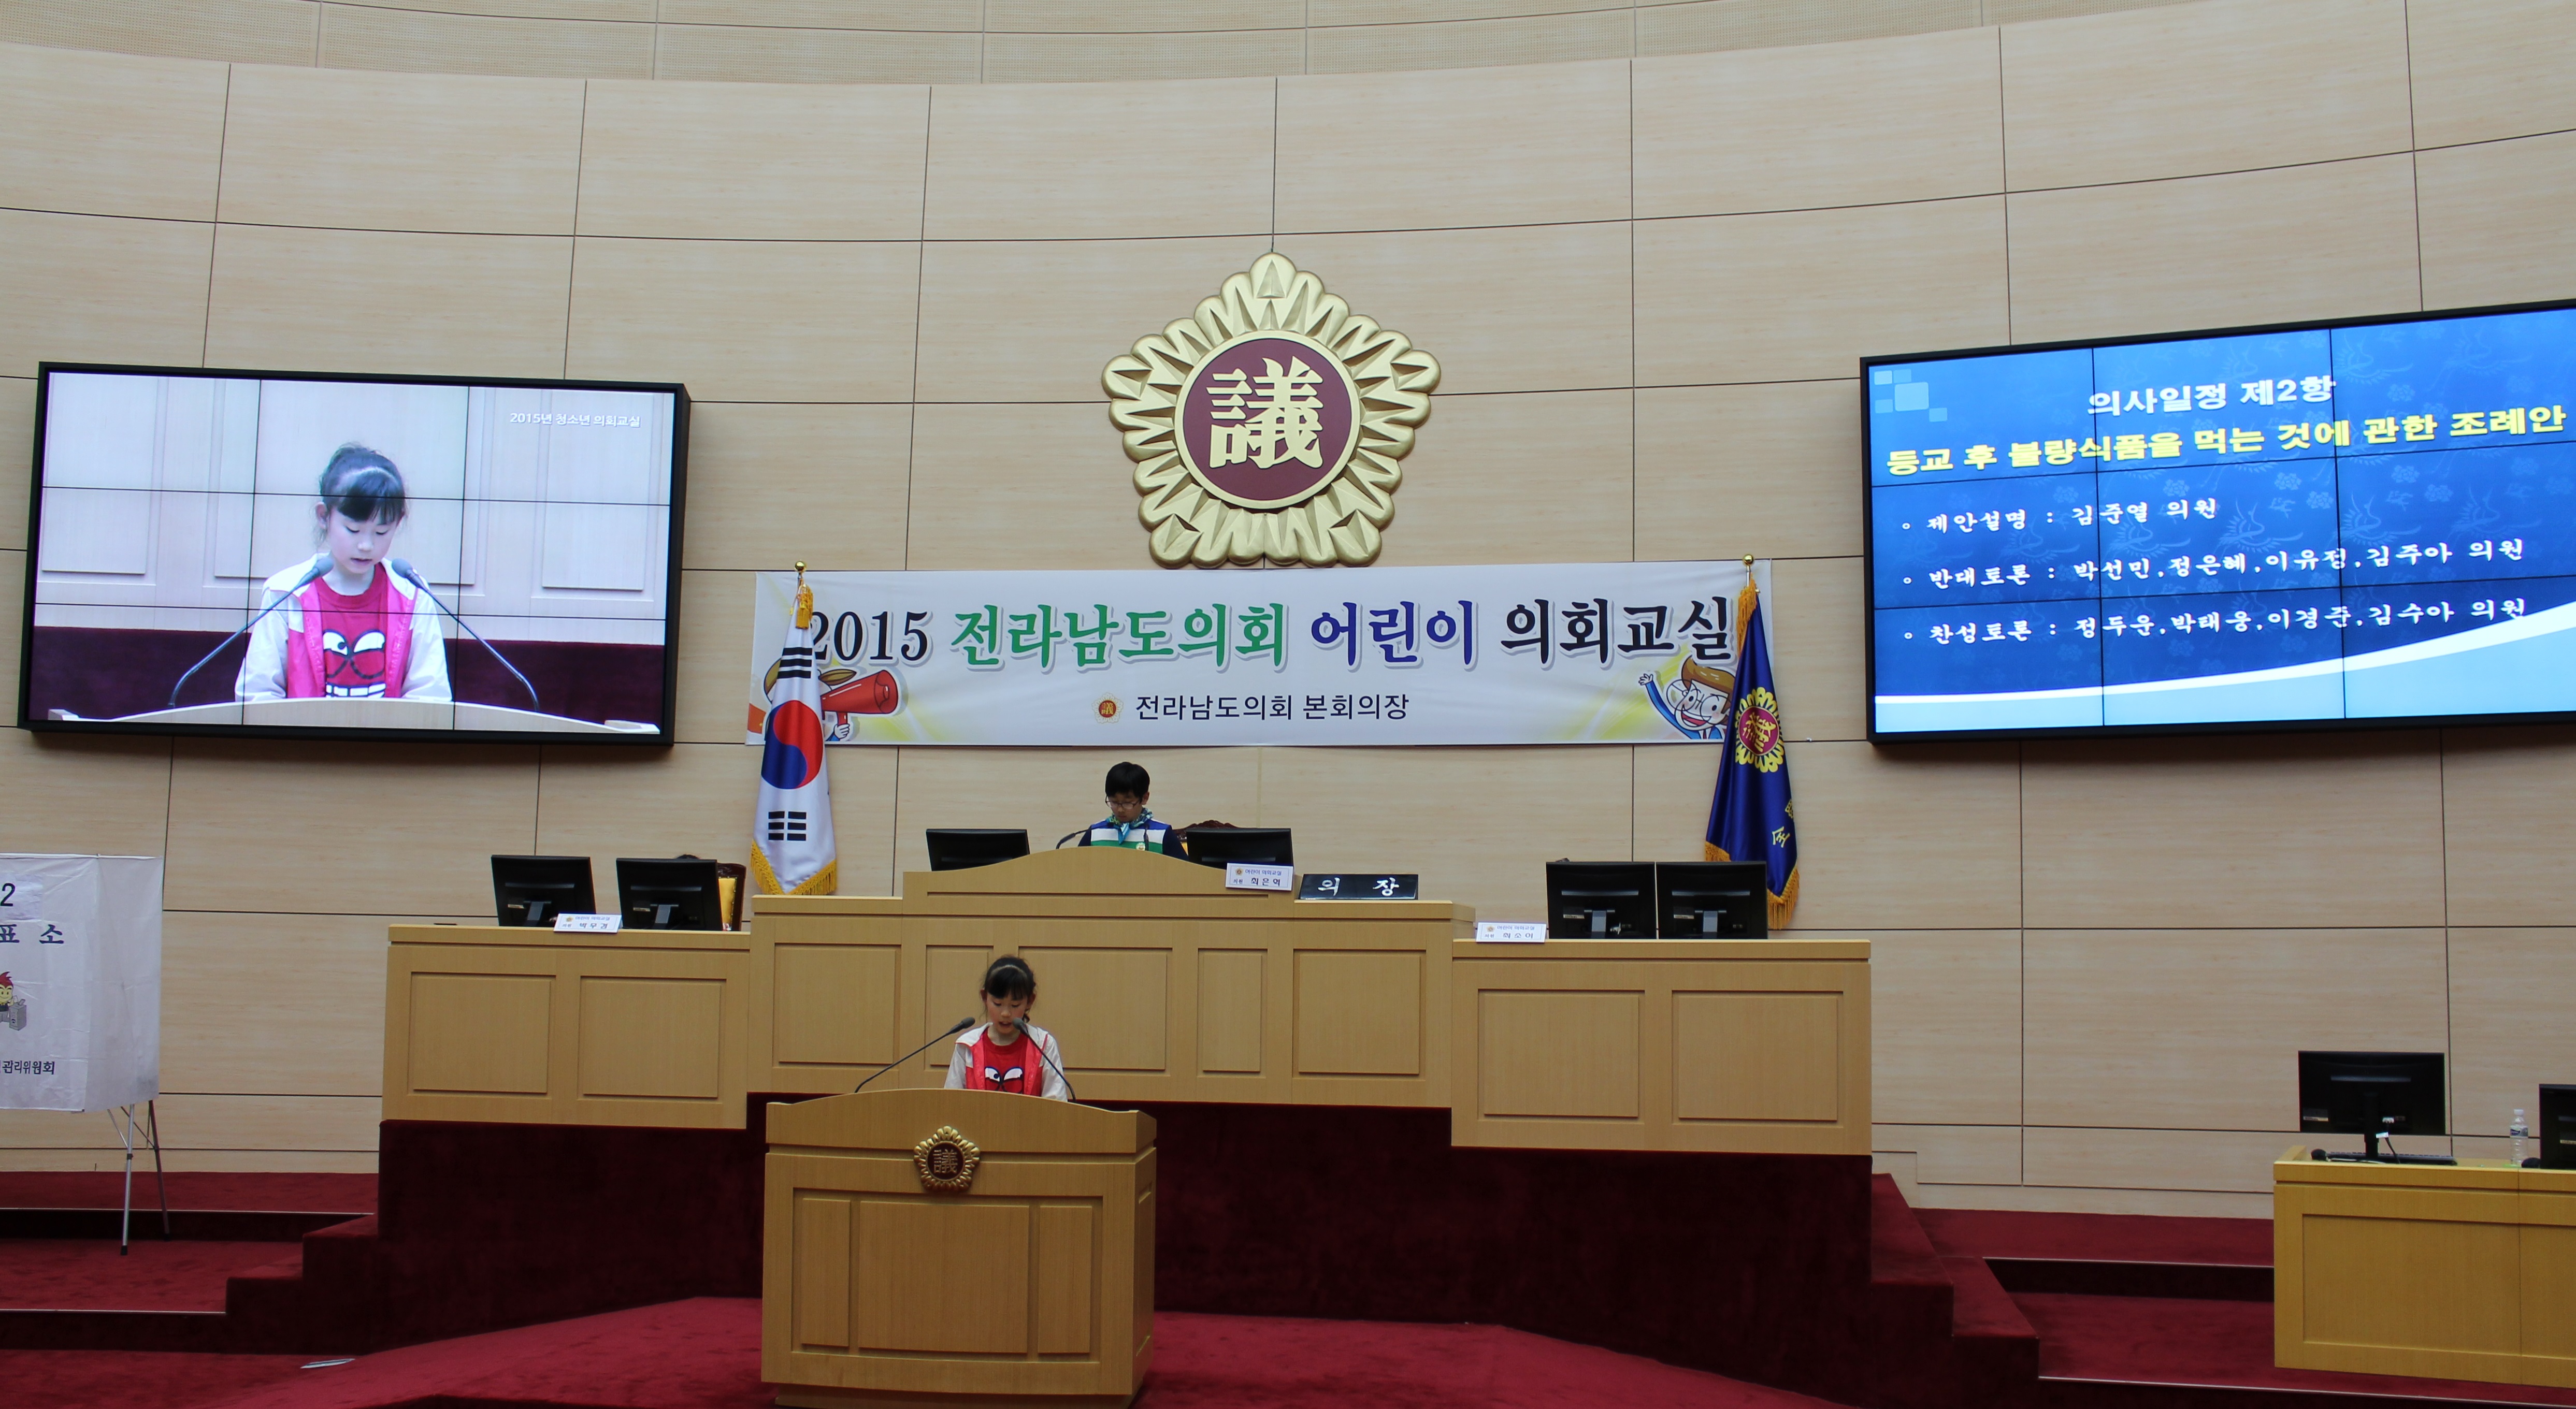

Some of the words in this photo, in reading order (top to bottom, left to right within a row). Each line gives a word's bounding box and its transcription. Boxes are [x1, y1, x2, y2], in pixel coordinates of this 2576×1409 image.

[1206, 356, 1323, 469] 議
[2087, 383, 2227, 416] 의사일정
[2240, 375, 2337, 405] 제2항
[510, 413, 552, 425] 2015년
[555, 414, 591, 426] 청소년
[593, 415, 641, 427] 의회교실
[1887, 449, 1954, 475] 등교
[1964, 445, 1998, 470] 후
[2008, 432, 2183, 468] 불량식품을
[2195, 427, 2266, 454] 먹는
[2278, 420, 2351, 451] 것에
[2363, 414, 2438, 444] 관한
[2450, 405, 2567, 437] 조례안
[1927, 509, 2027, 534] 제안설명
[2072, 501, 2149, 526] 김준열
[2167, 498, 2217, 520] 의원
[1929, 564, 2031, 589] 반대토론
[2469, 539, 2524, 561] 의원
[810, 611, 929, 661] 2015
[952, 603, 1285, 668] 전라남도의회
[1311, 600, 1474, 666] 어린이
[1501, 596, 1731, 664] 의회교실
[1931, 620, 2032, 645] 찬성토론
[2471, 598, 2526, 620] 의원
[1135, 694, 1292, 721] 전라남도의회
[1303, 694, 1409, 720] 본회의장
[1, 883, 16, 907] 2
[0, 1060, 55, 1075] 관리위원회
[933, 1149, 958, 1174] 議
